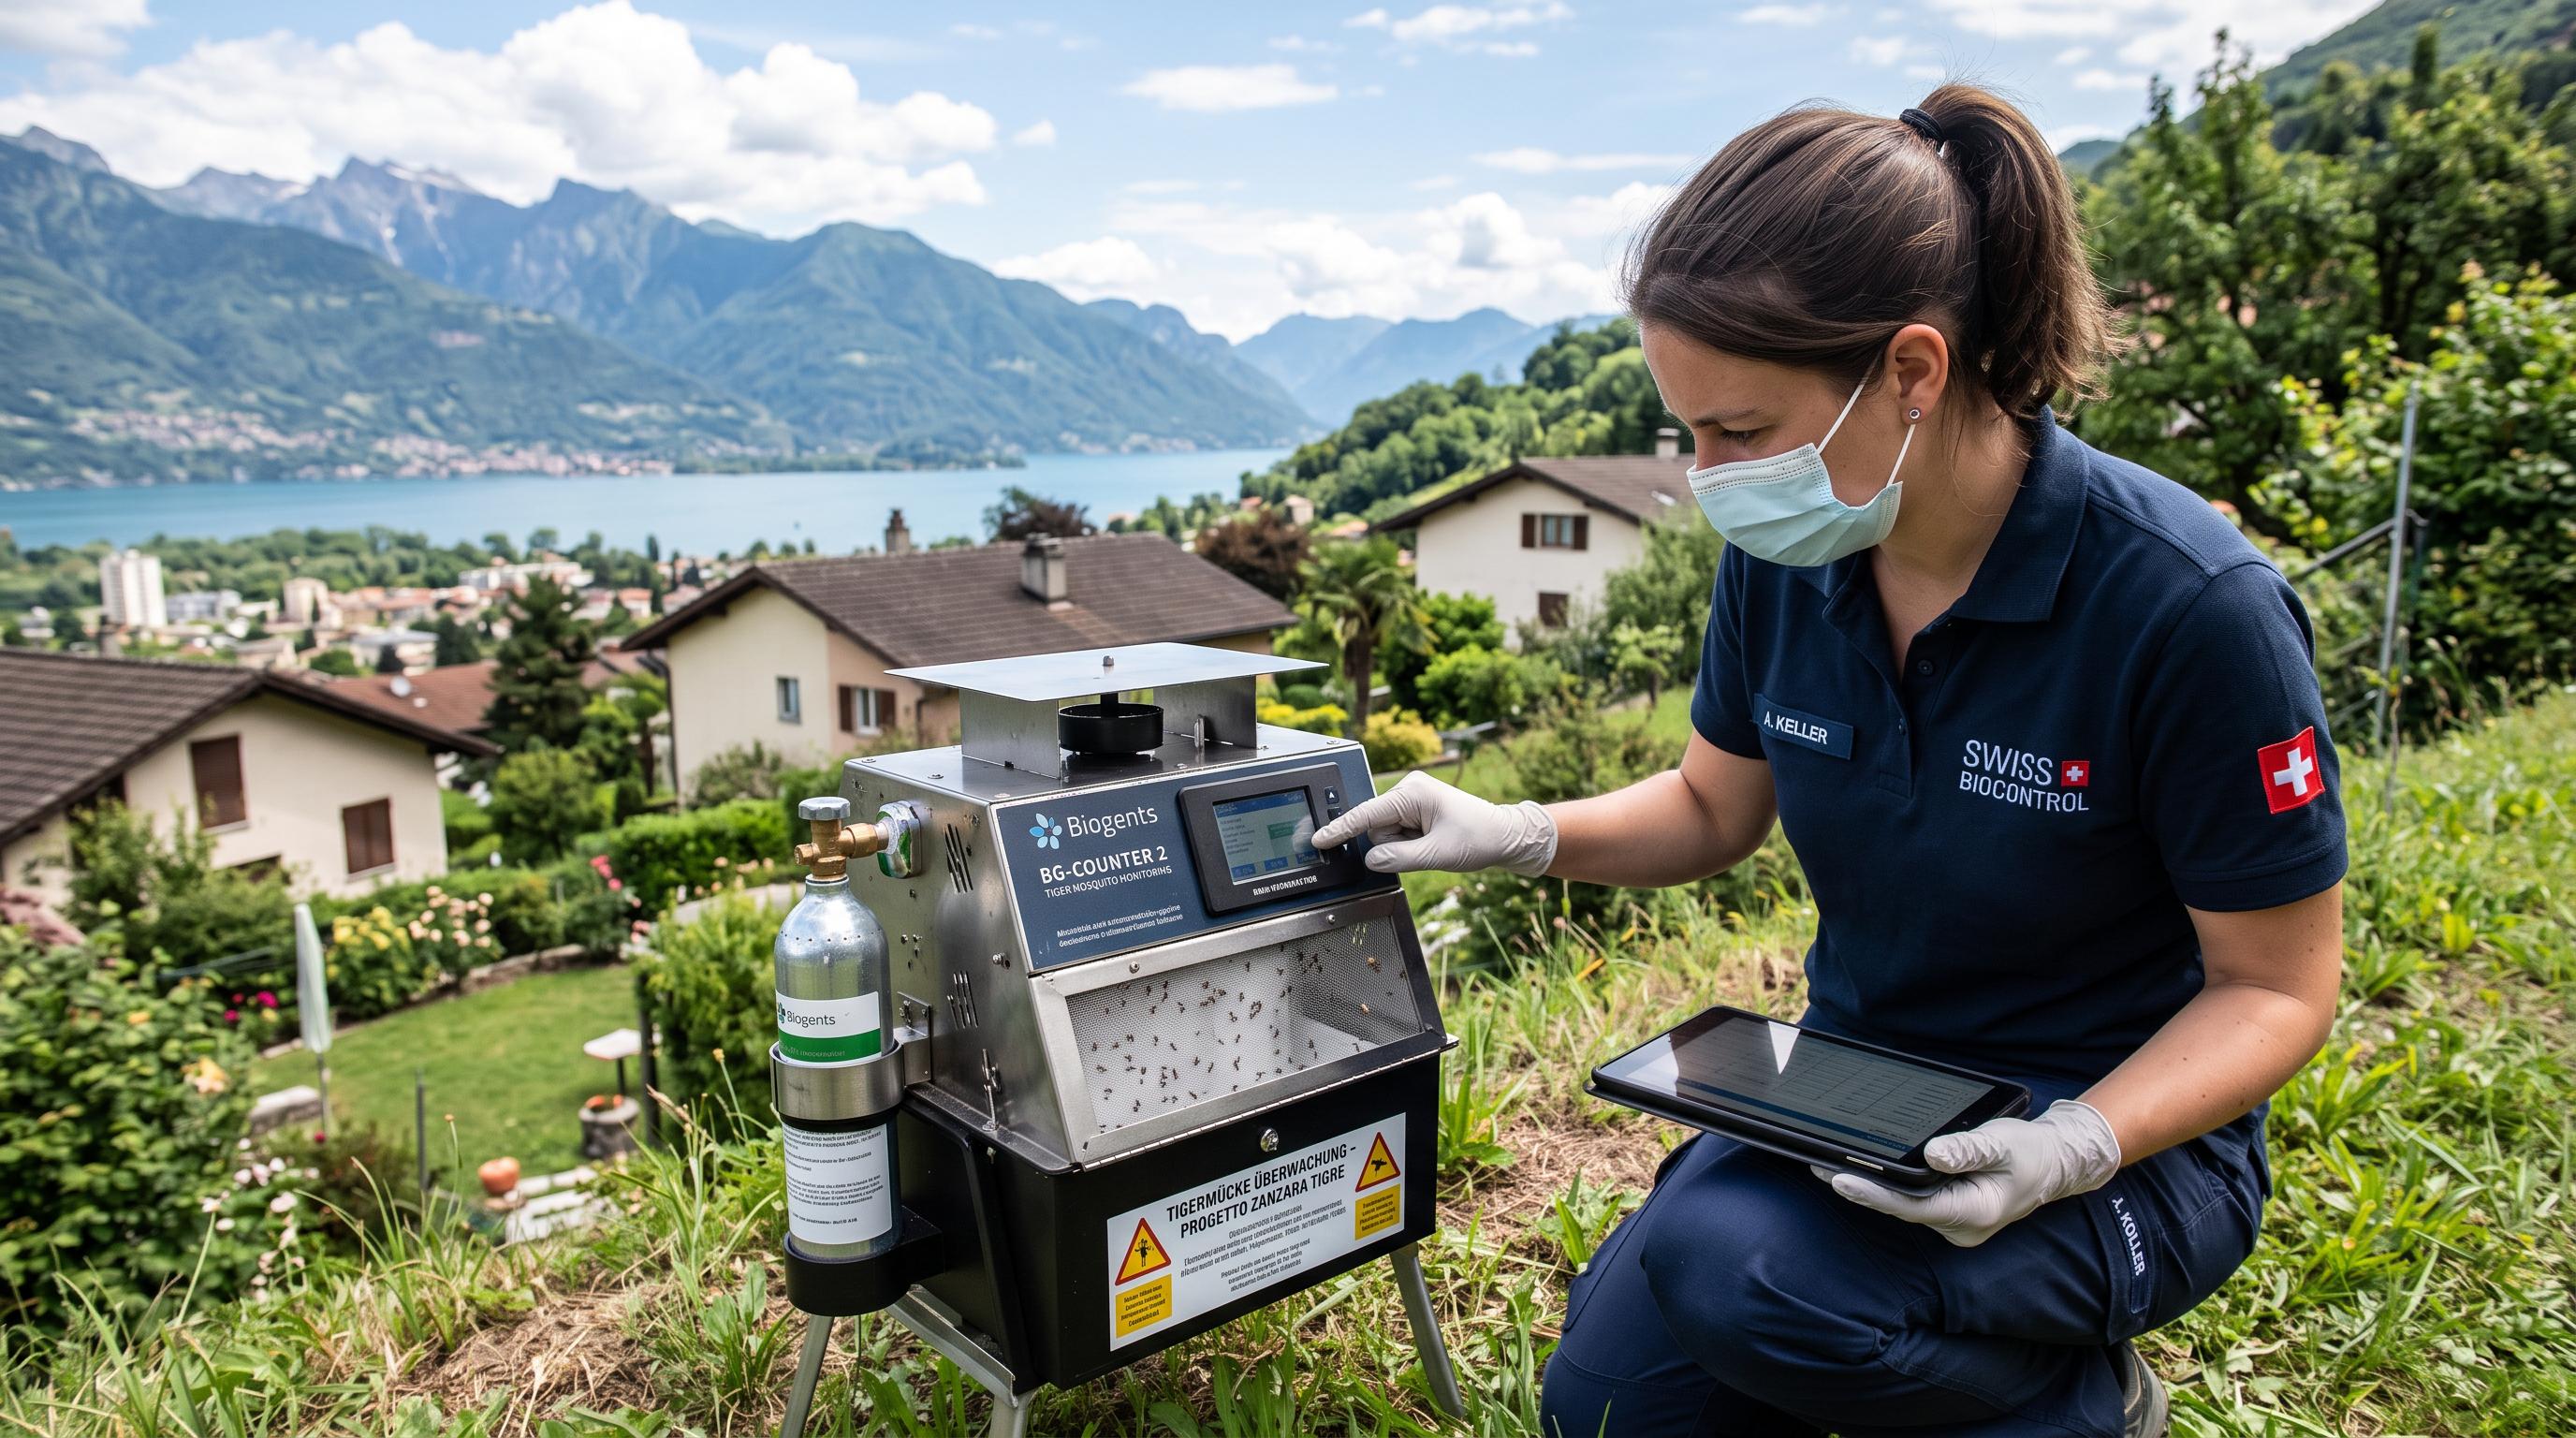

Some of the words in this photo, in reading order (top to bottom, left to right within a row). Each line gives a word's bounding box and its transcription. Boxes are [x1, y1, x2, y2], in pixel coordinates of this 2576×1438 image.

[1764, 711, 1774, 728] A.
[1776, 714, 1828, 745] KELLER
[1963, 739, 2054, 786] SWISS
[1959, 770, 2090, 813] BIOCONTROL
[1067, 806, 1158, 838] Biogents
[1039, 848, 1154, 884] BG-COUNTER
[1156, 845, 1168, 861] 2
[1045, 885, 1072, 899] TIGER
[1072, 875, 1119, 893] MOSQUITO
[786, 1010, 836, 1028] Biogents
[1166, 1178, 1251, 1222] TIGERMÜCKE
[1254, 1143, 1347, 1190] ÜBERWACHUNG
[1180, 1200, 1248, 1239] PROGETTO
[1251, 1178, 1309, 1212] ZANZARA
[1310, 1164, 1345, 1189] TIGRE
[2120, 1211, 2145, 1277] KOLLER
